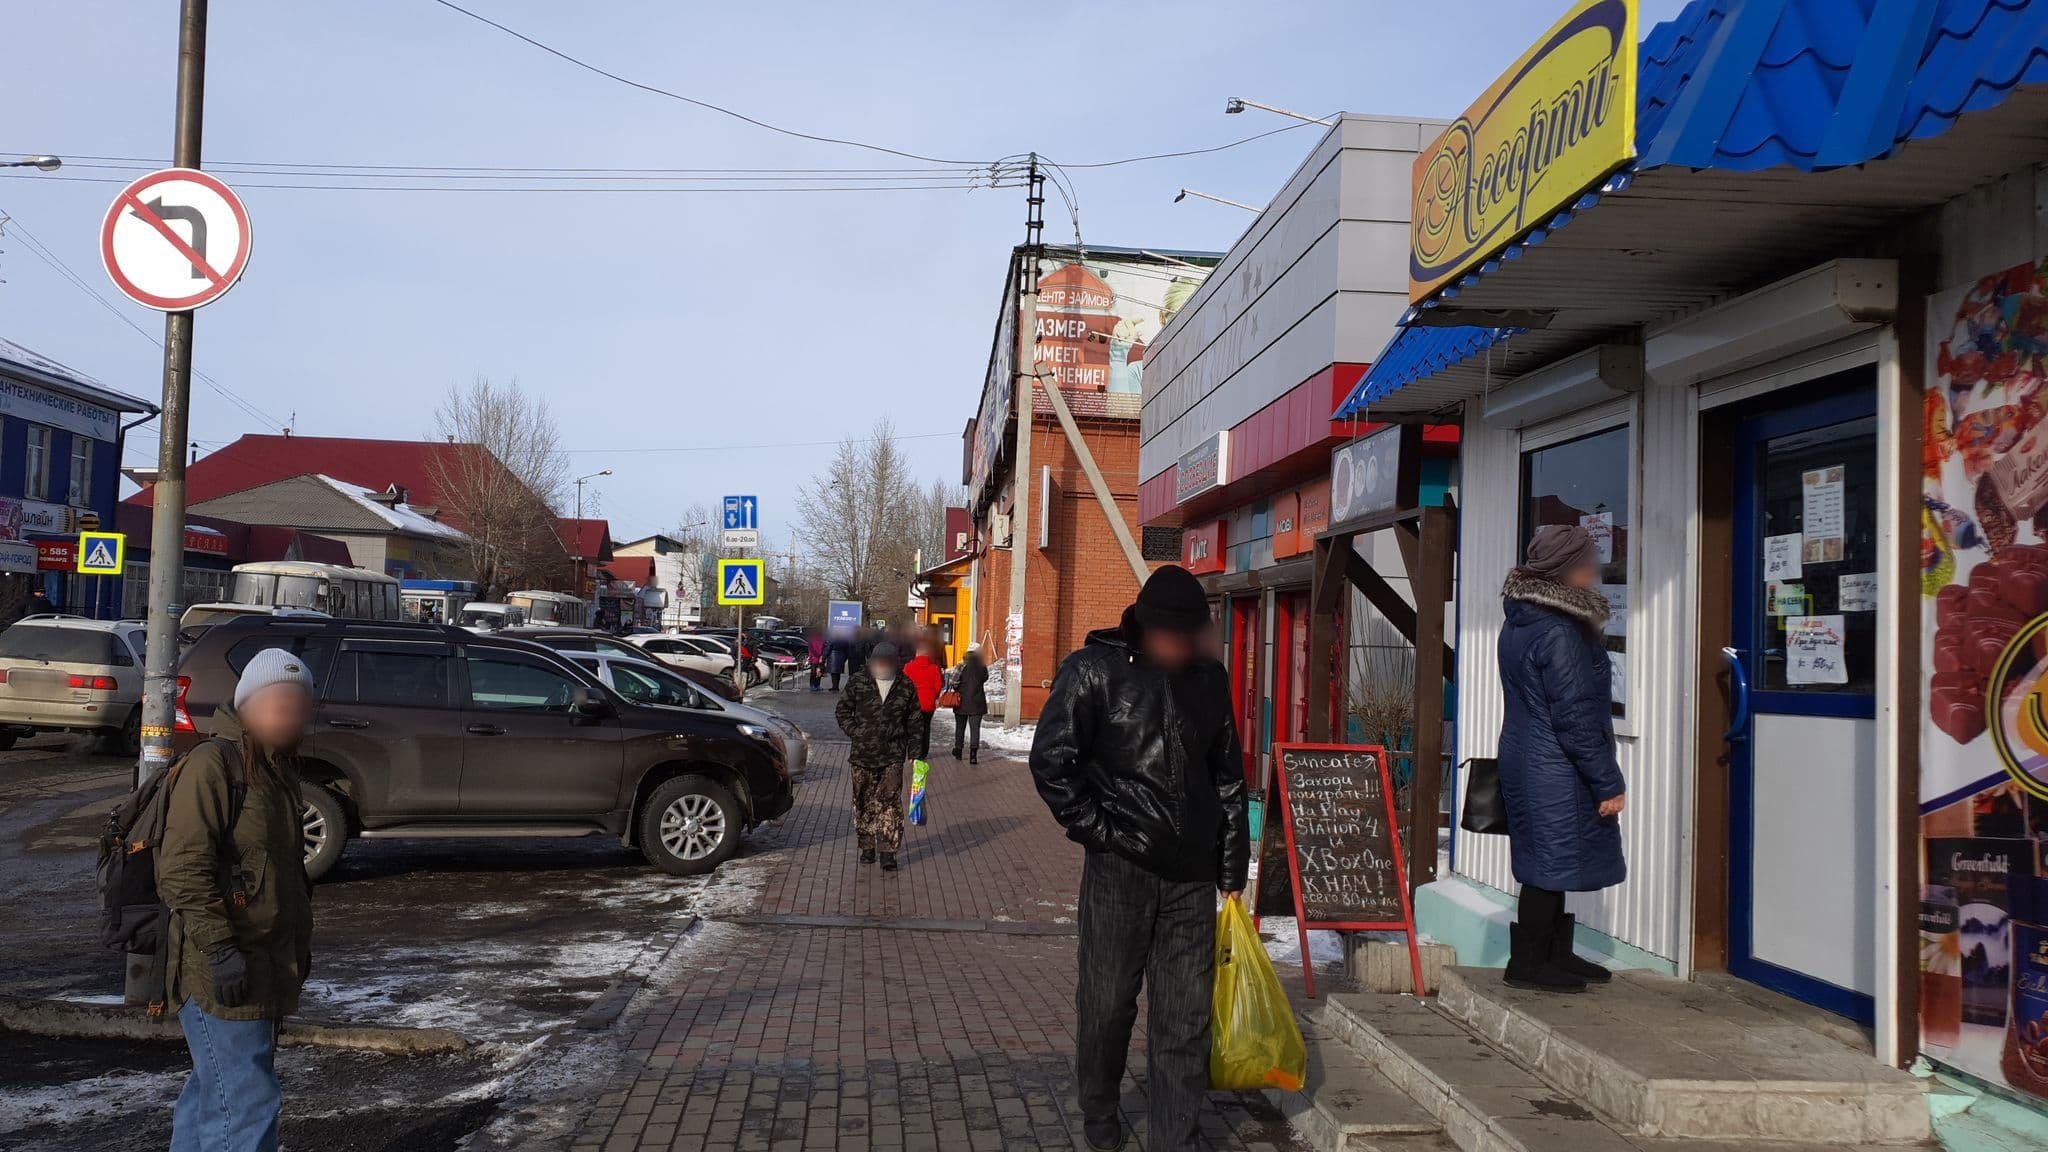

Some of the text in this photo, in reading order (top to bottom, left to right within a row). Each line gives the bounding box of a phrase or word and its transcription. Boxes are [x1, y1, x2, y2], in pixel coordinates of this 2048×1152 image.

[1068, 292, 1110, 306] ЗАЙМОВ
[1034, 317, 1086, 338] АЗМЕР
[1033, 344, 1079, 363] ИМЕЕТ
[49, 547, 68, 555] 585
[1284, 753, 1361, 770] Suncafe
[1294, 773, 1353, 790] Заходи
[1365, 816, 1379, 838] 4
[1951, 852, 2008, 874] Greenfield
